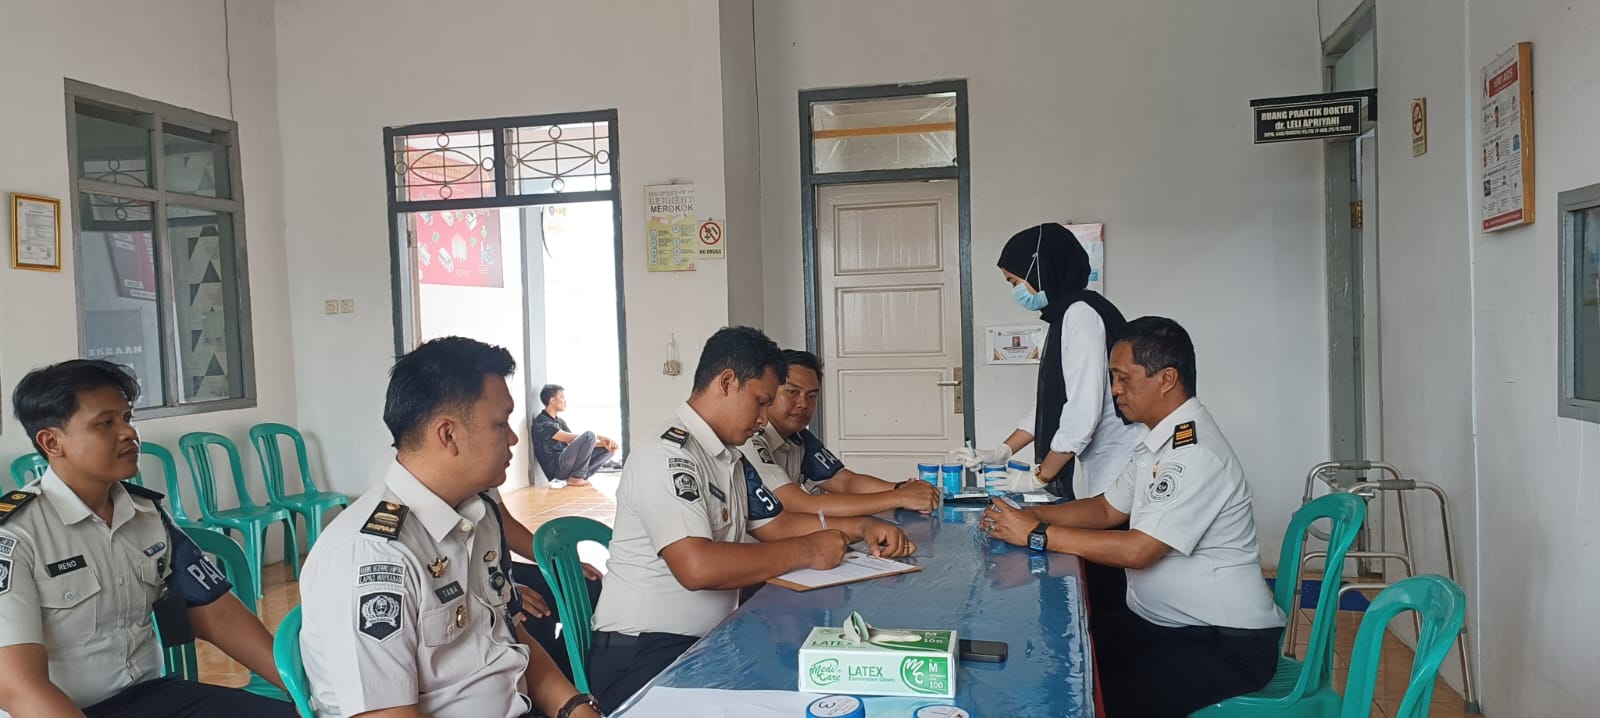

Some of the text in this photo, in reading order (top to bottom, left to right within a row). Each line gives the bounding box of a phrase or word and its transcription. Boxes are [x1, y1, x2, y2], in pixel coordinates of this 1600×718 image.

[1262, 105, 1354, 120] RUANG PRAKTIK DOKTER
[1274, 116, 1340, 130] dr. LELI APRIYANI
[650, 204, 694, 213] MEROKOK
[57, 560, 77, 571] RENO
[811, 640, 853, 648] LATEX
[848, 665, 883, 677] LATEX
[928, 663, 938, 673] M
[929, 681, 944, 689] 100
